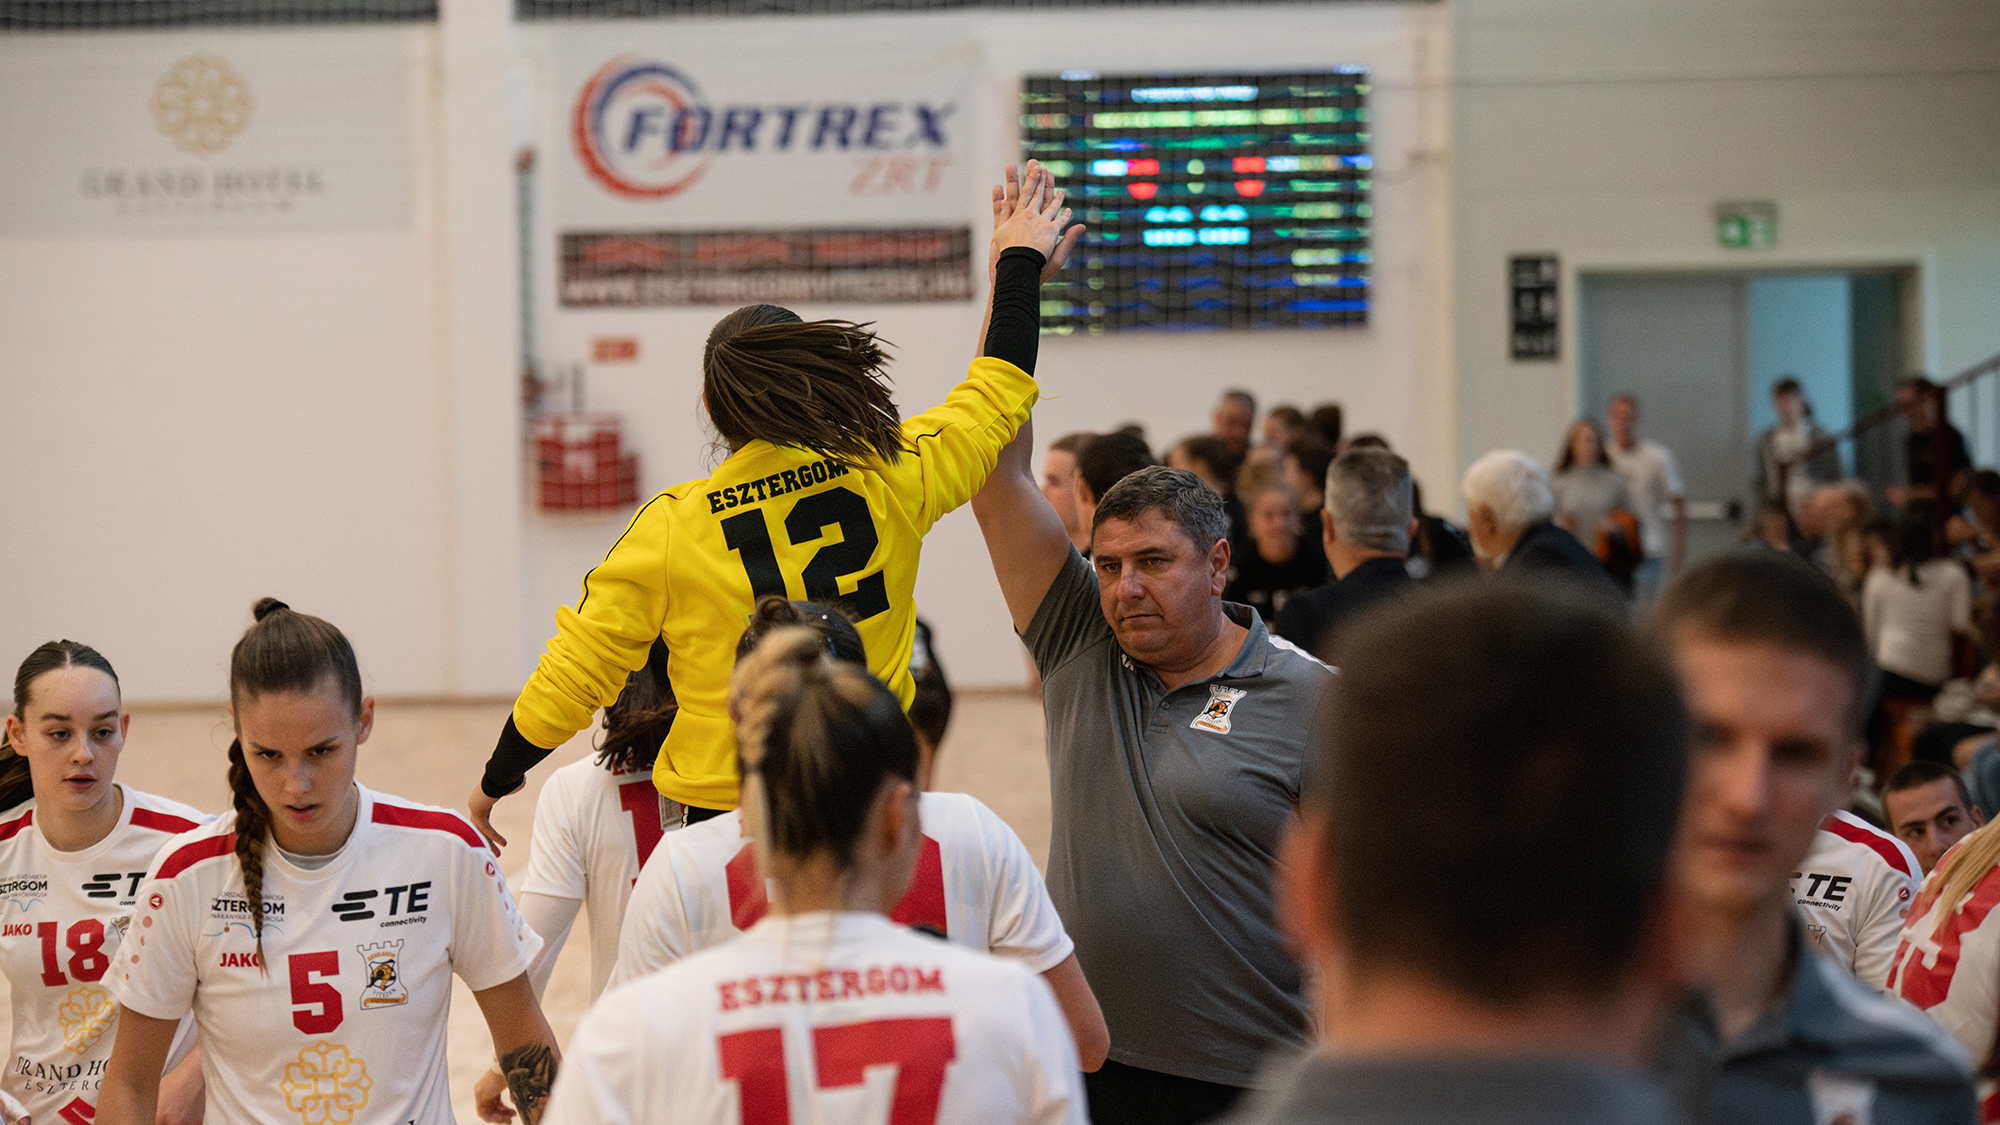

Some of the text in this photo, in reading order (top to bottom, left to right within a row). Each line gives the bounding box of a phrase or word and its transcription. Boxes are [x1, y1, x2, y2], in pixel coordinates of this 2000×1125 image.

[623, 102, 958, 152] FORTREX
[850, 155, 953, 194] ZRT
[706, 459, 850, 514] ESZTERGOM
[720, 486, 890, 626] 12
[211, 899, 285, 915] ZTEROM
[384, 881, 432, 916] TE
[1797, 898, 1842, 911] connectivity
[1807, 873, 1853, 902] TE
[2, 923, 33, 937] JAKO
[380, 915, 428, 928] connectivity
[37, 918, 110, 988] 18
[288, 950, 344, 1035] 5
[716, 965, 946, 1013] ESZTERGOM
[718, 1015, 958, 1125] 17
